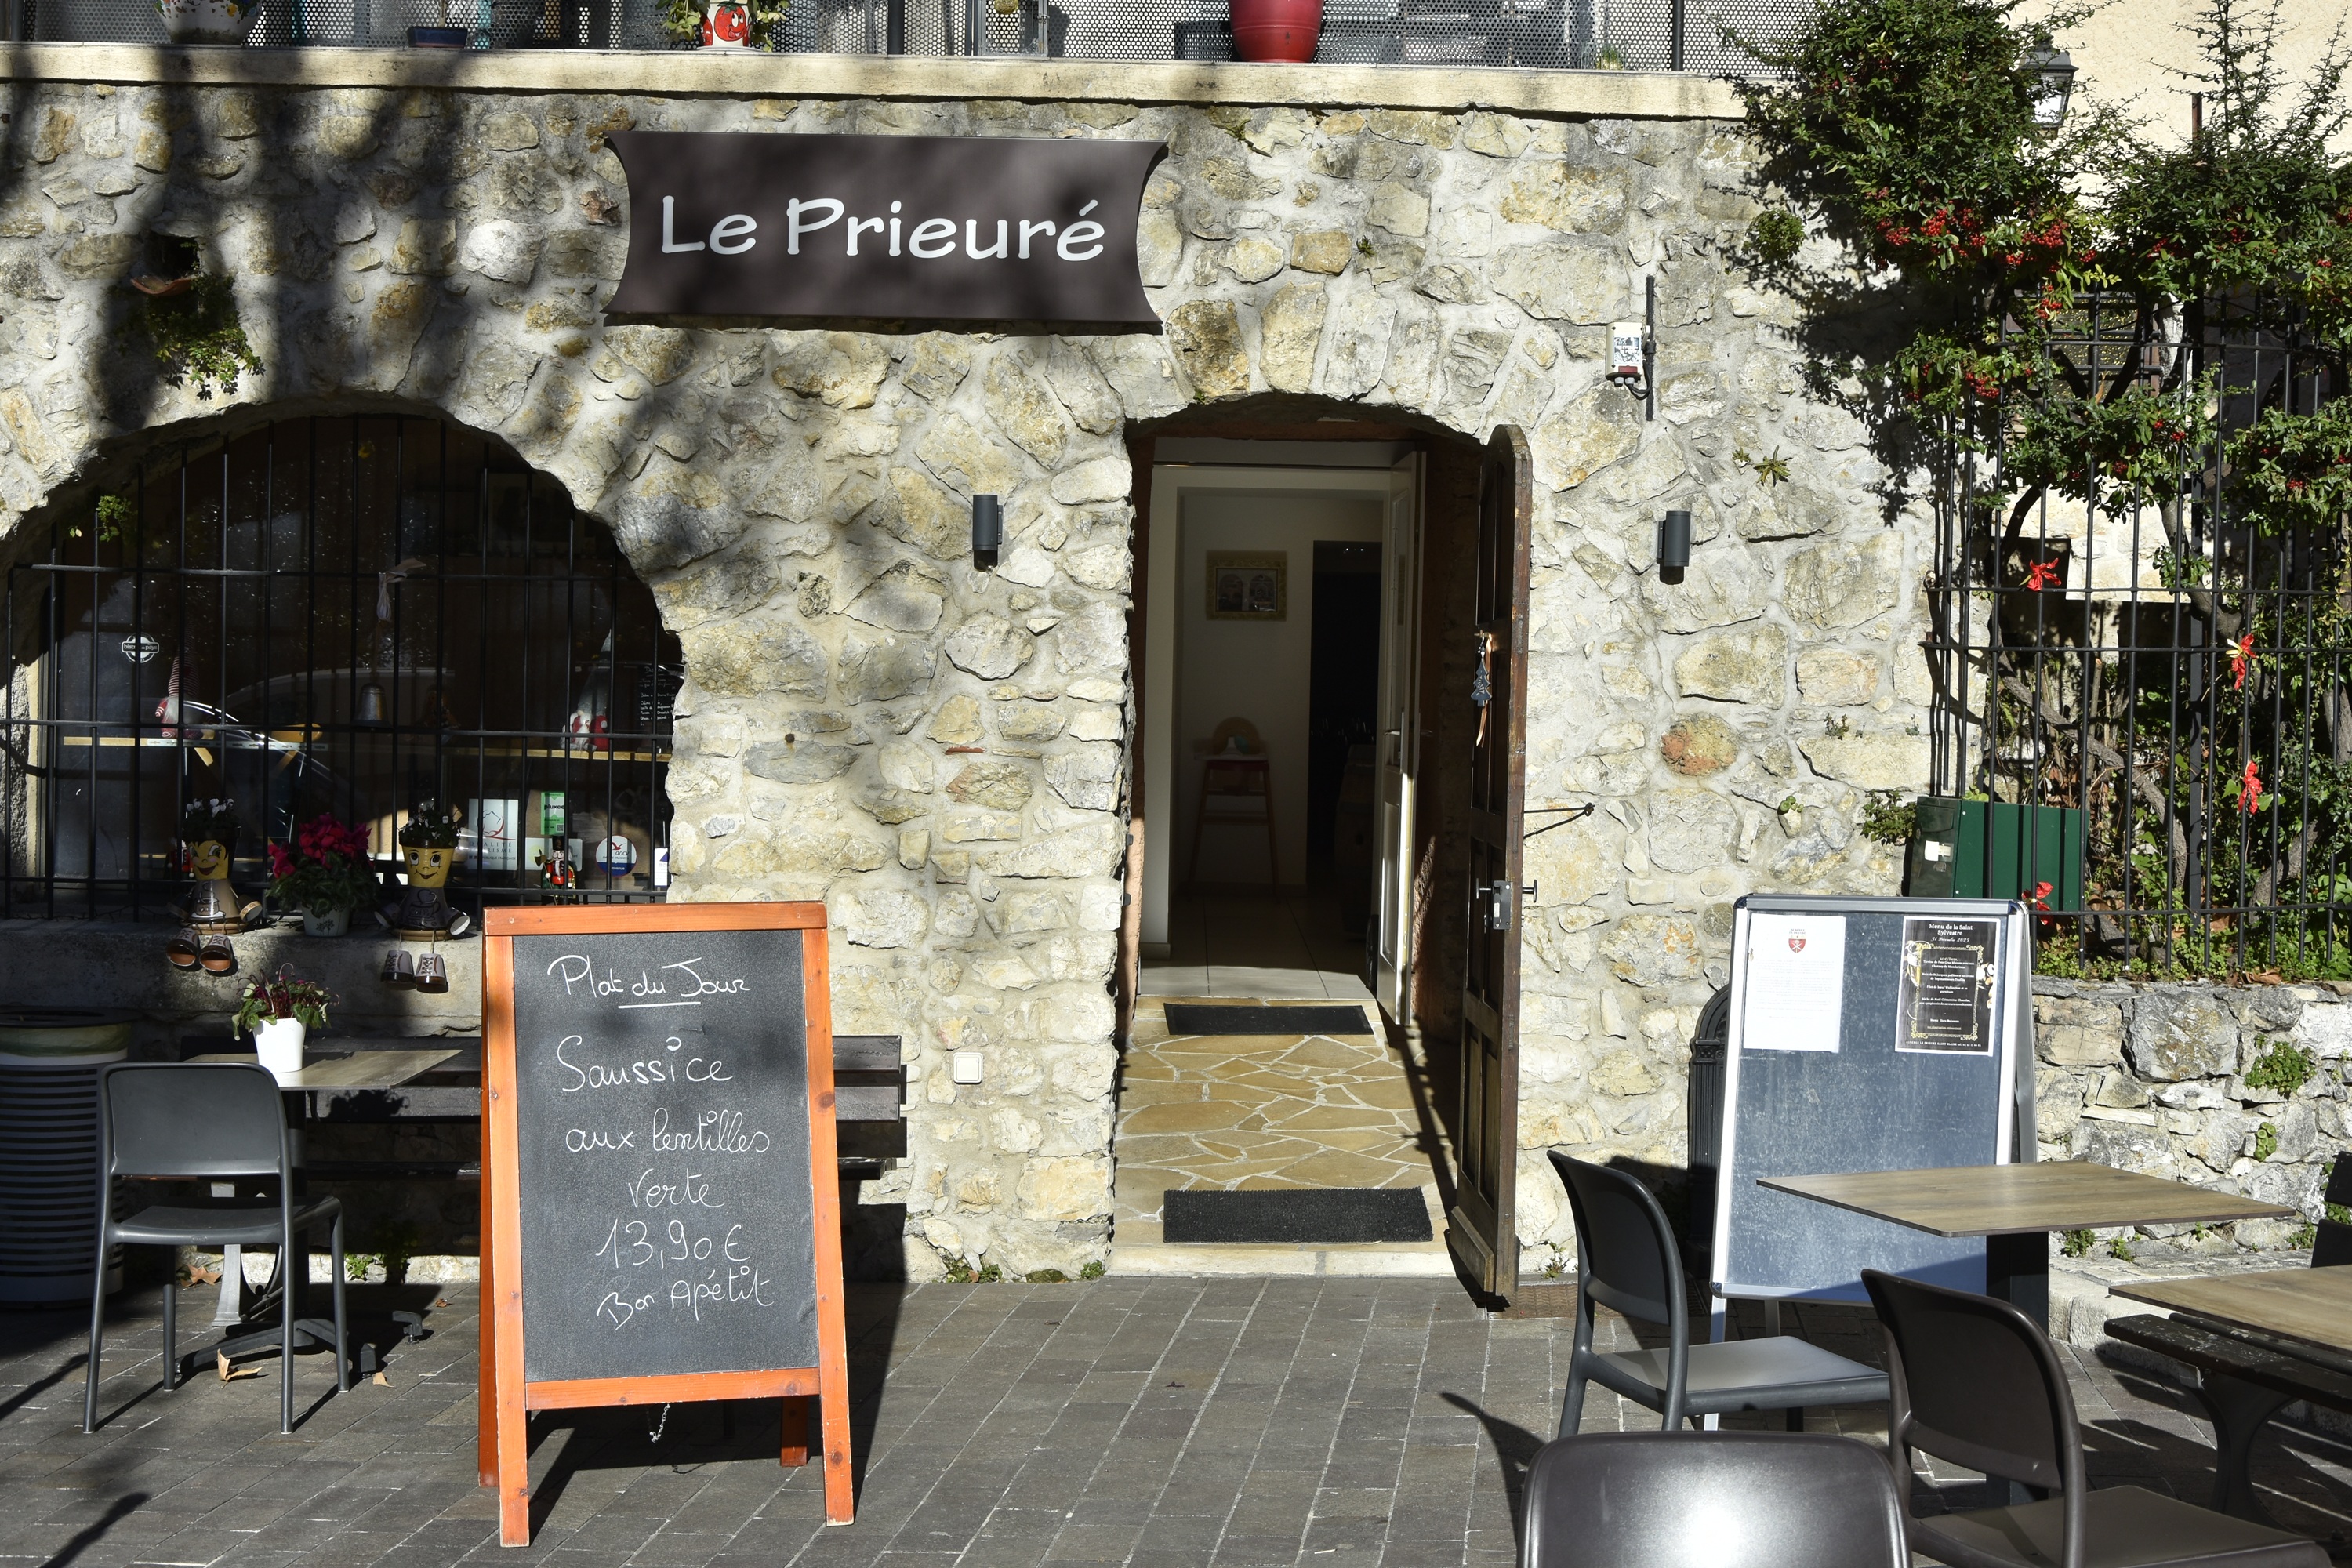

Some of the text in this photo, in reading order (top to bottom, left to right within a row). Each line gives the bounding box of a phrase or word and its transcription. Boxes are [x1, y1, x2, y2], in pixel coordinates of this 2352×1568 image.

[661, 195, 1105, 261] Le Prieuré
[546, 954, 751, 998] Plat du Jour
[557, 1035, 734, 1092] Saussice
[565, 1107, 770, 1153] aux lentilles
[628, 1168, 725, 1208] Verte
[595, 1218, 751, 1269] 13,90 €
[597, 1265, 774, 1330] Bon Apétit
